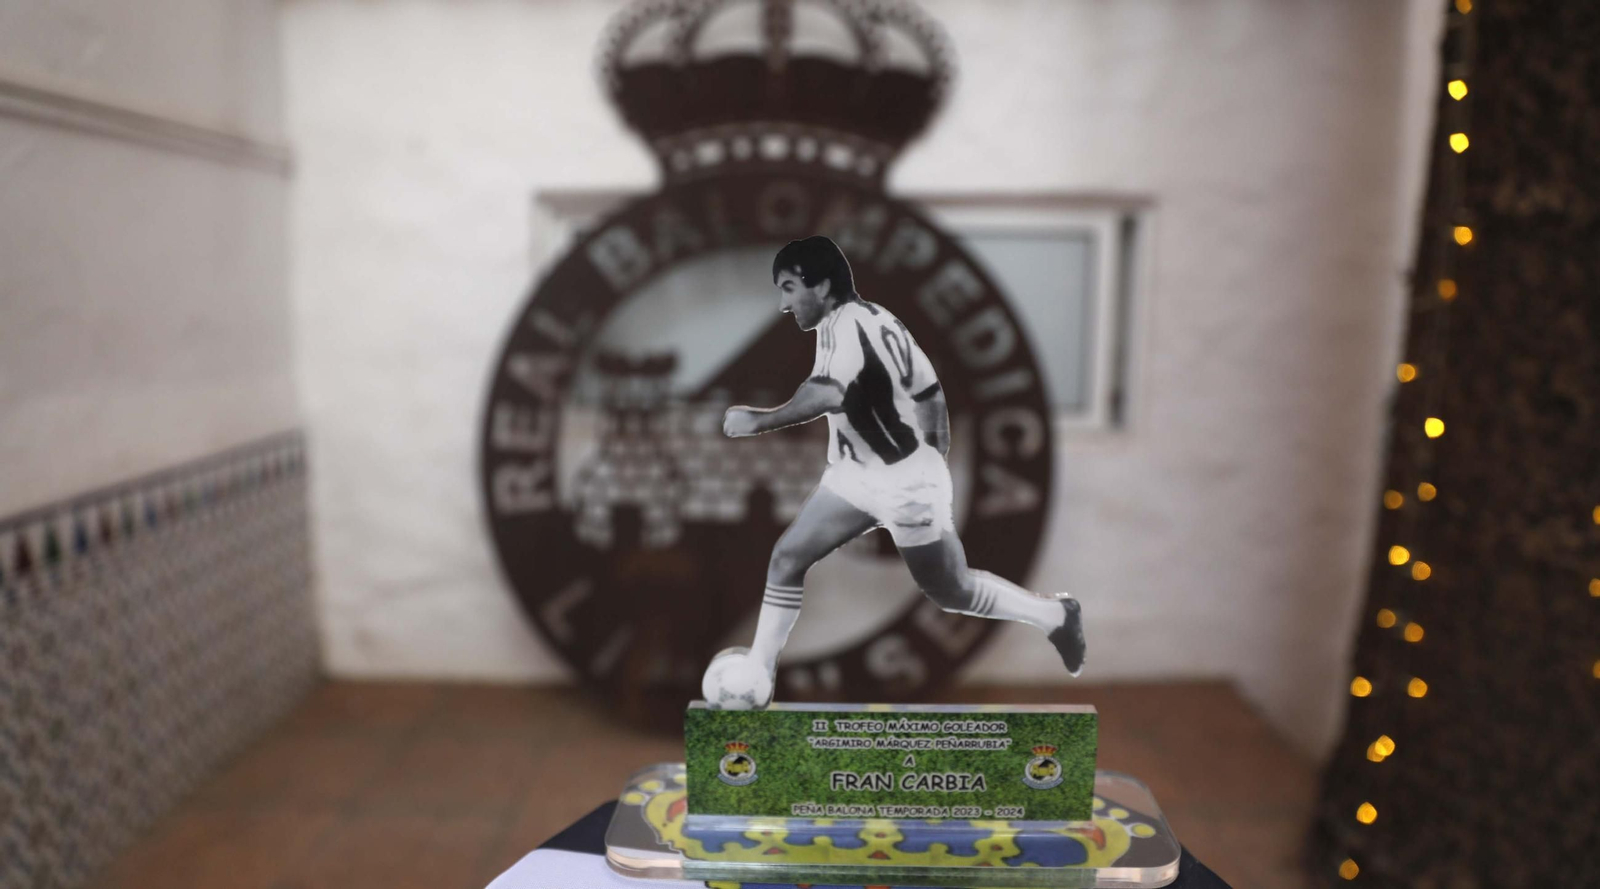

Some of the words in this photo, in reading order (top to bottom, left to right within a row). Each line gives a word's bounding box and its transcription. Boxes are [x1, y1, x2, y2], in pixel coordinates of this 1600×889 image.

[491, 303, 592, 513] REAL
[812, 720, 828, 732] II
[835, 720, 883, 732] TROFEO
[886, 718, 939, 732] MÁXIMO
[942, 720, 1008, 733] GOLEADOR
[876, 736, 931, 750] MÁRQUEZ
[903, 755, 915, 767] A
[831, 772, 893, 791] FRAN
[901, 773, 987, 792] CARBIA
[792, 802, 824, 816] PEÑA
[827, 804, 875, 816] BALONA
[878, 804, 949, 817] TEMPORADA
[953, 805, 981, 817] 2023
[996, 805, 1025, 817] 2024
